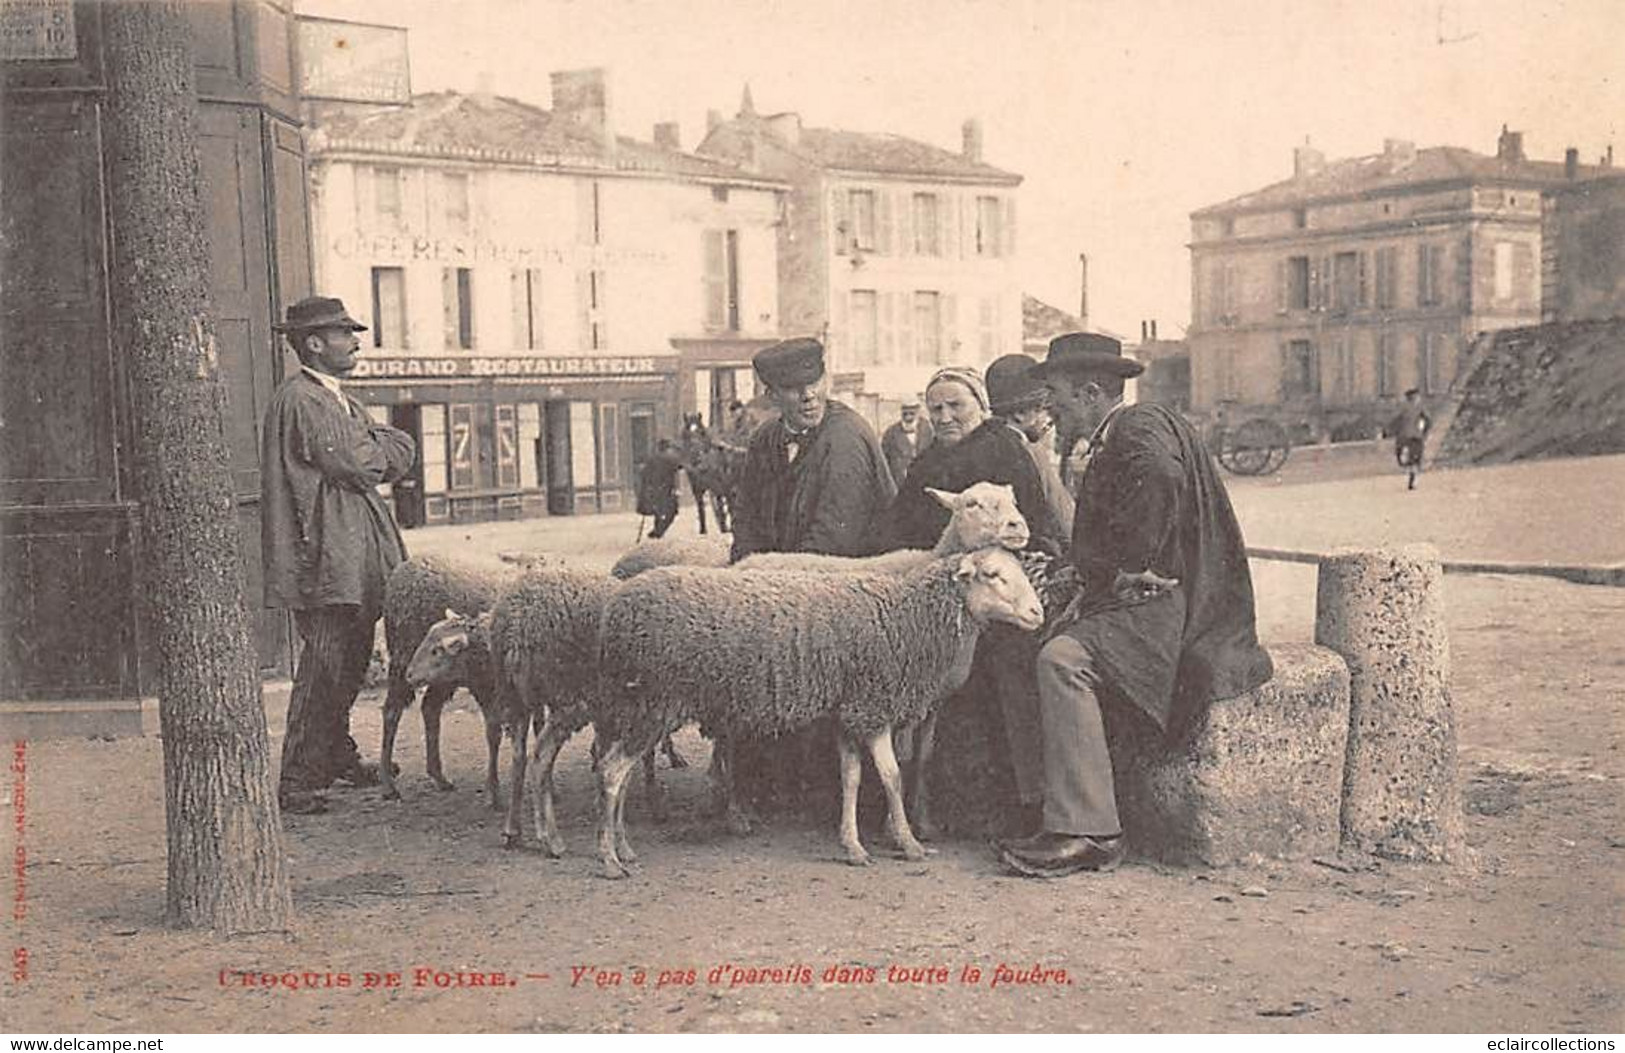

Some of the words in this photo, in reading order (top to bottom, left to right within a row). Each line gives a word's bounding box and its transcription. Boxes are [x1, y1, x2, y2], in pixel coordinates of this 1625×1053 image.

[47, 28, 65, 42] 10
[351, 358, 458, 377] DURAND
[471, 357, 655, 376] RESTAURATEUR
